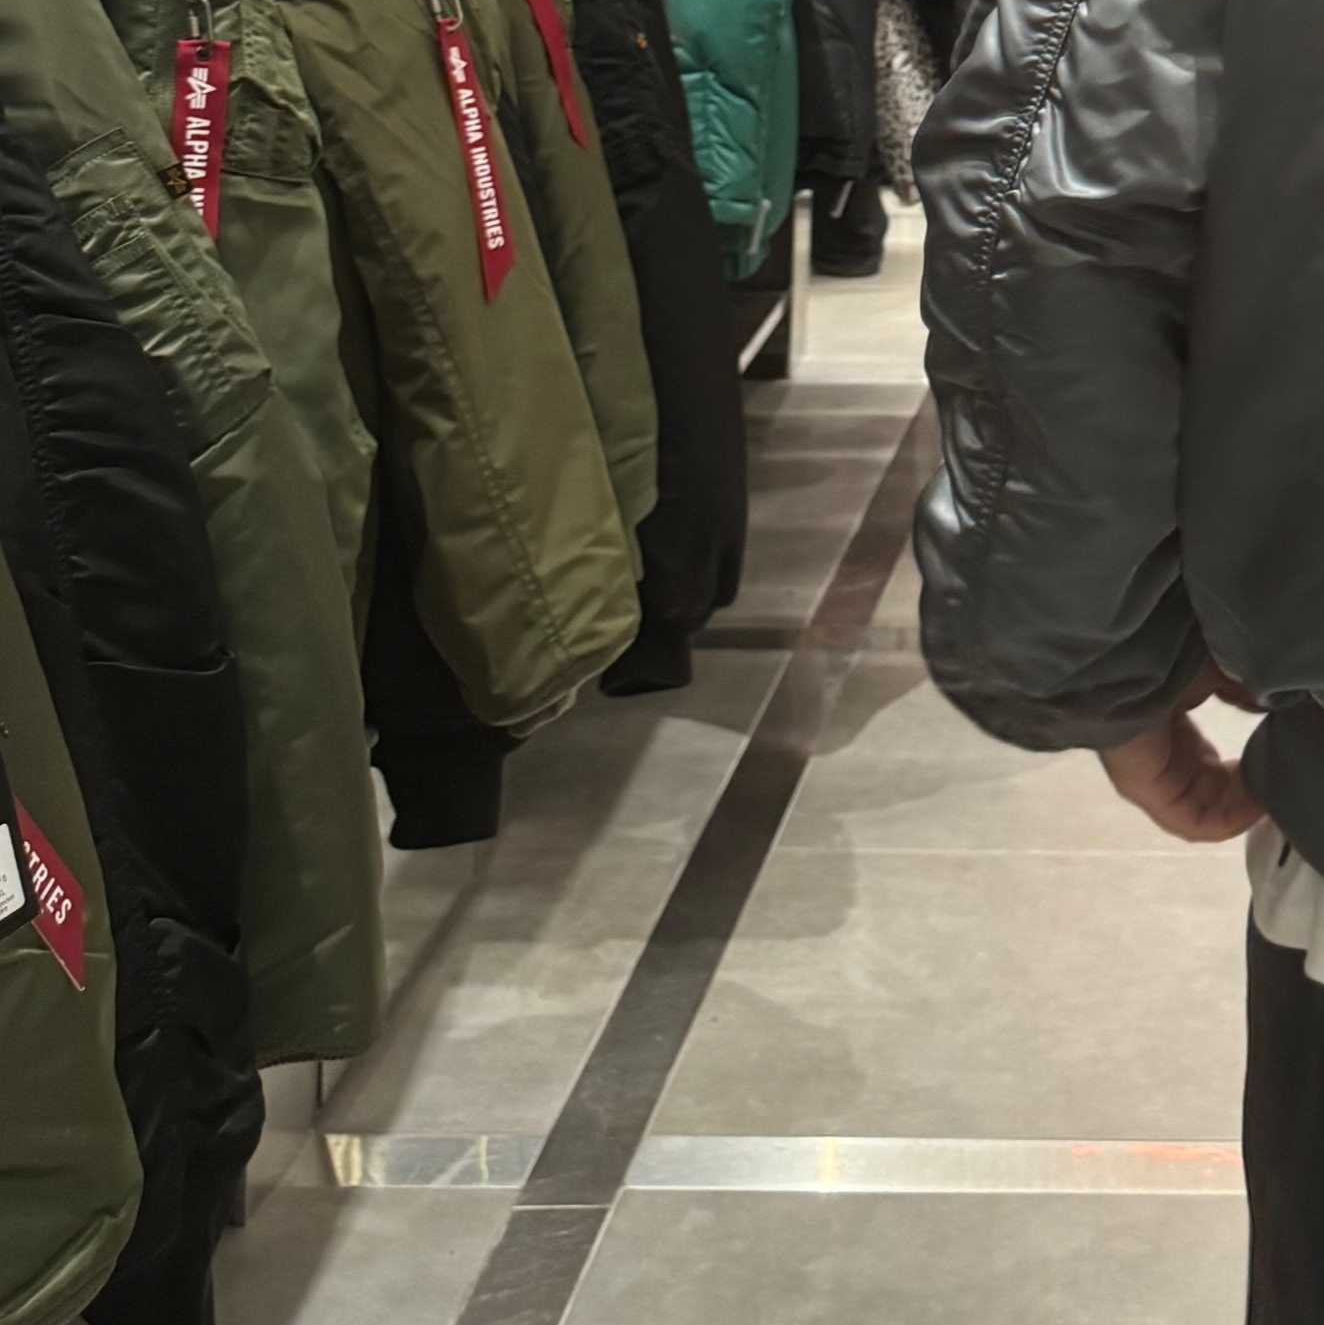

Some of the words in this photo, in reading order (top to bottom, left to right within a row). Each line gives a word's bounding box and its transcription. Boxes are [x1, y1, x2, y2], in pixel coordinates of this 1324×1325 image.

[183, 116, 211, 180] ALPHA
[457, 88, 484, 144] ALPHA
[470, 146, 505, 250] INDUSTRIES
